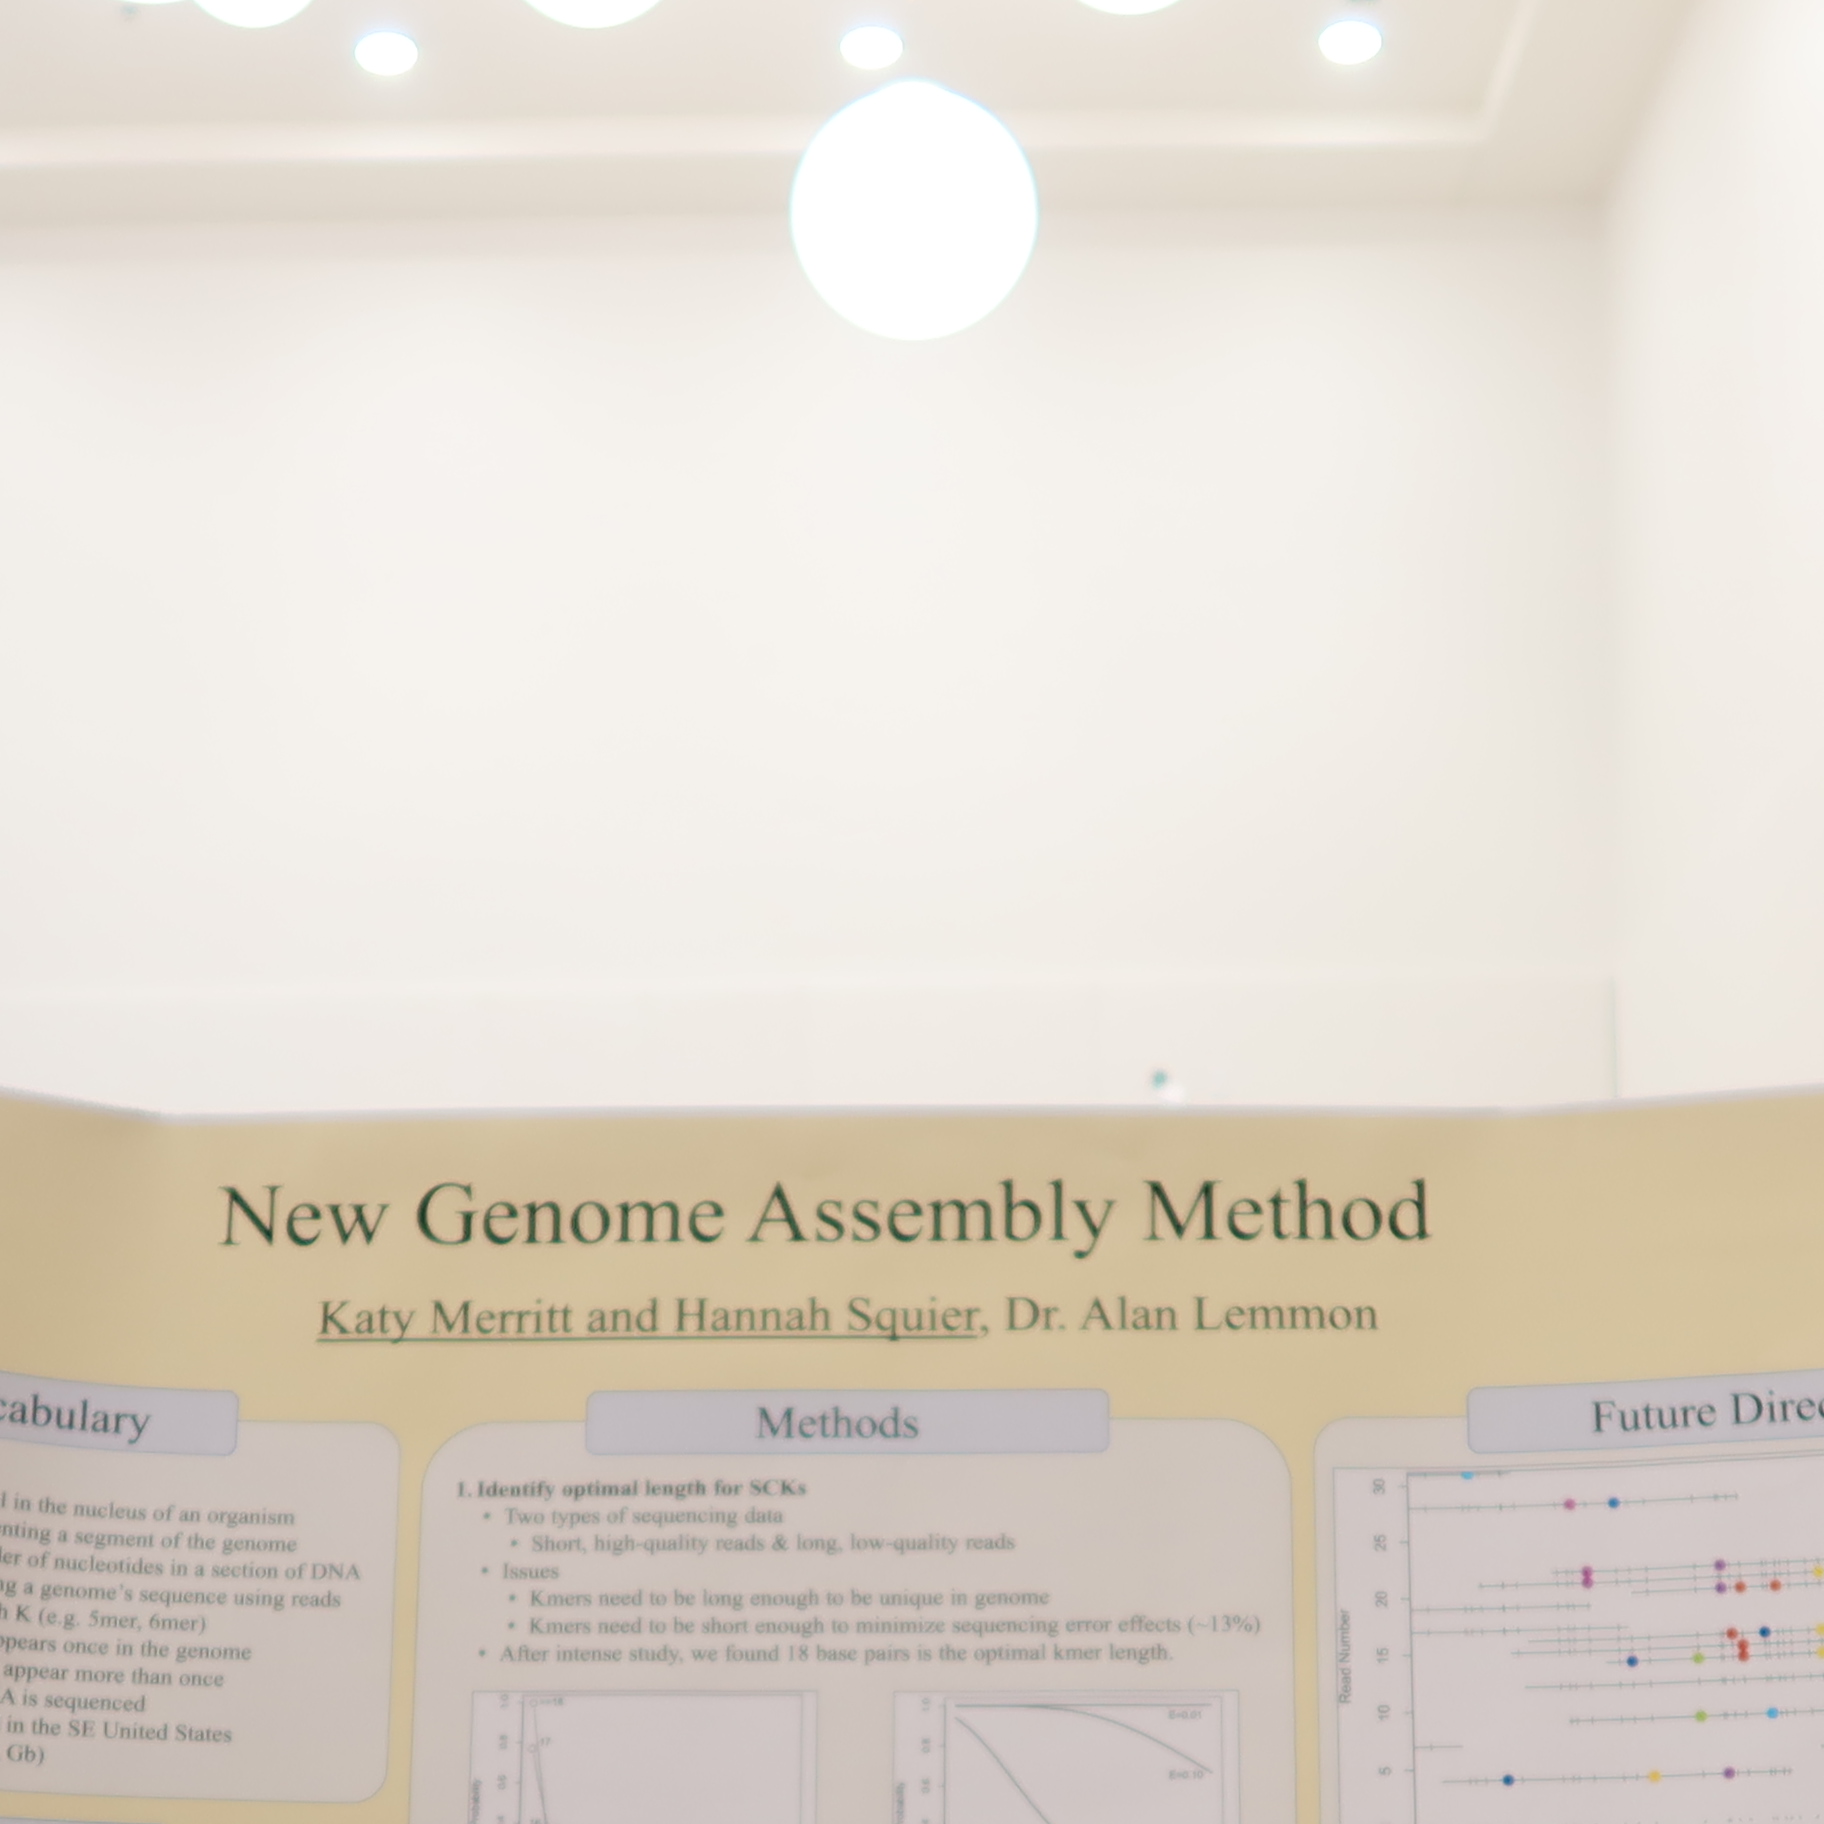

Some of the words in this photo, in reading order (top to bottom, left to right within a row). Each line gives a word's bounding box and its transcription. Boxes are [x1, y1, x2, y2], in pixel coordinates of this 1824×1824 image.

[218, 1185, 390, 1246] New
[417, 1182, 725, 1245] Genome
[746, 1179, 1116, 1259] Assembly
[1145, 1178, 1430, 1241] Method
[318, 1298, 416, 1344] Katy
[430, 1298, 574, 1335] Merritt
[587, 1298, 658, 1334] and
[676, 1296, 833, 1334] Hannah
[847, 1296, 989, 1343] Squier,
[1007, 1297, 1065, 1331] Dr.
[1080, 1296, 1178, 1331] Alan
[1195, 1297, 1380, 1332] Lemmon
[757, 1405, 920, 1439] Methods
[1593, 1400, 1716, 1433] Future
[478, 1477, 556, 1503] Identify
[562, 1477, 638, 1503] optimal
[645, 1476, 707, 1503] length
[714, 1477, 745, 1497] for
[750, 1477, 808, 1497] SCKs
[503, 1562, 560, 1580] Issues
